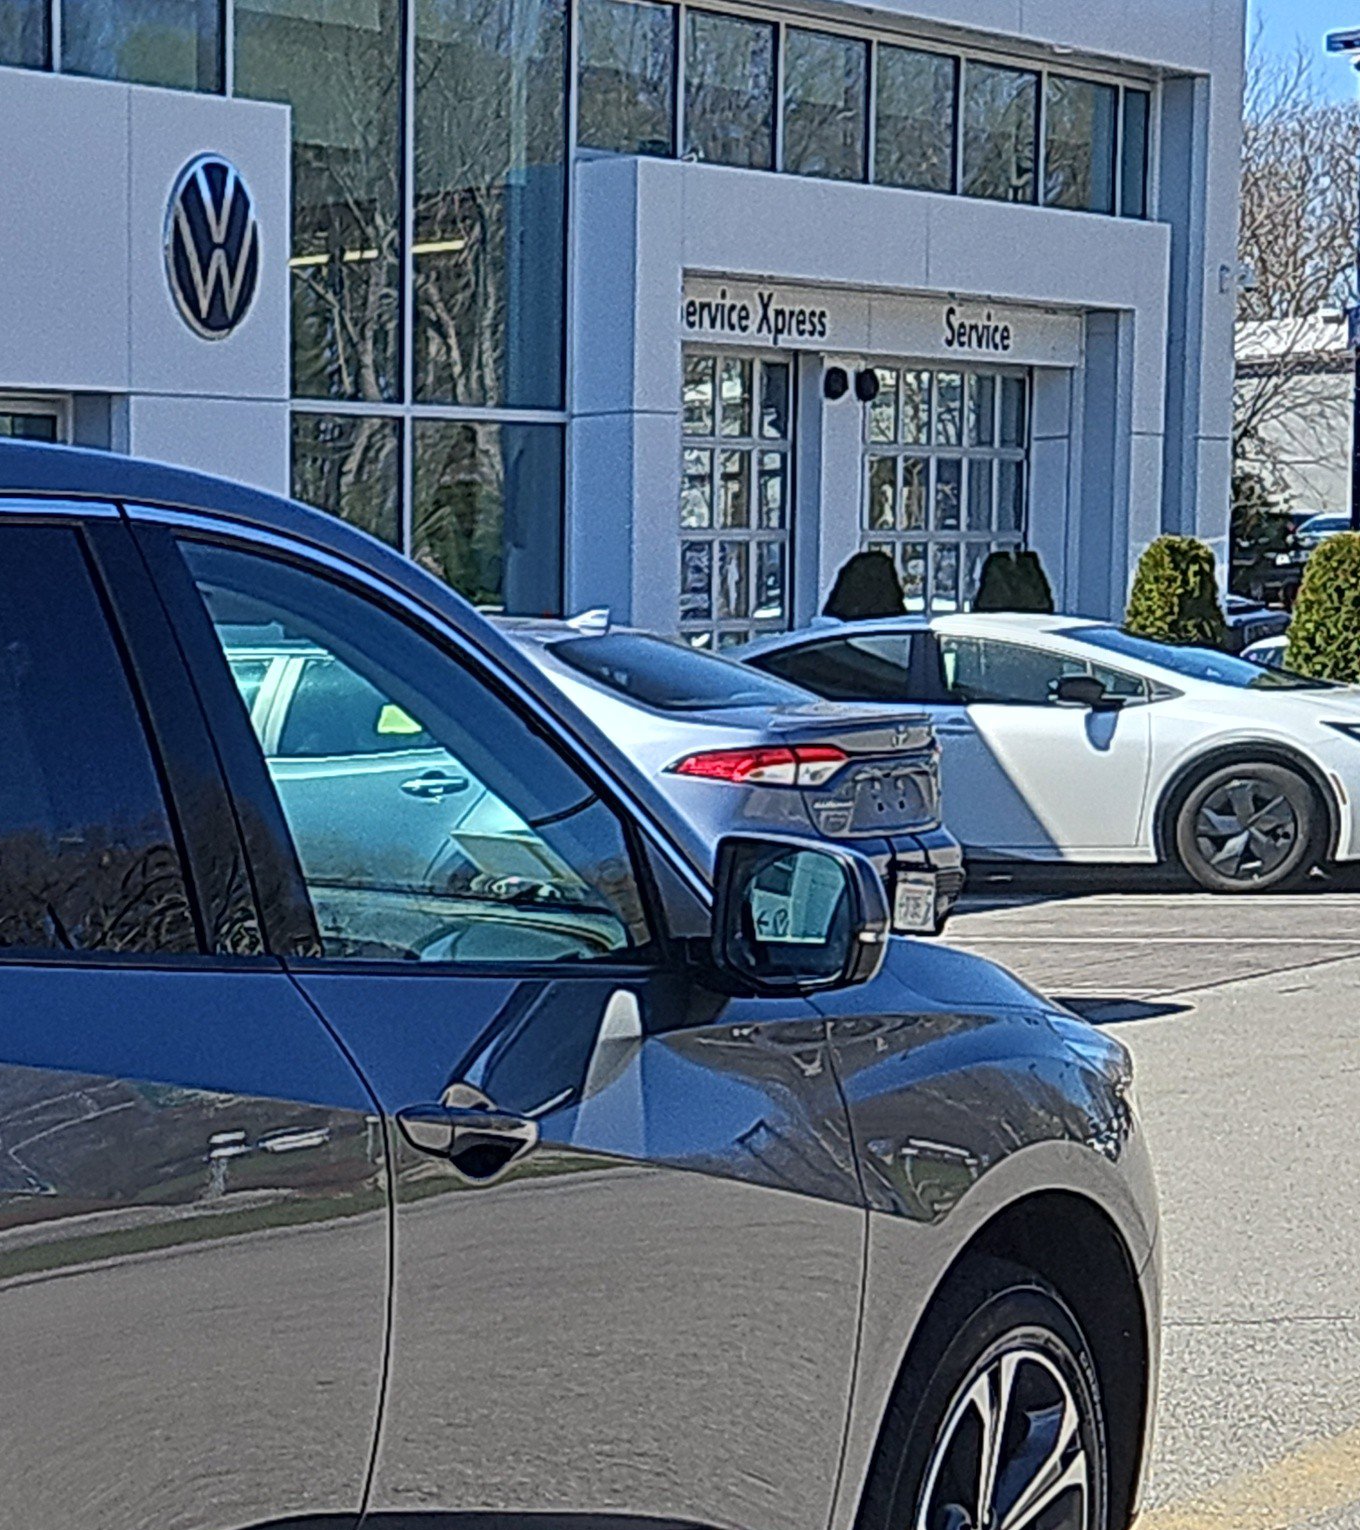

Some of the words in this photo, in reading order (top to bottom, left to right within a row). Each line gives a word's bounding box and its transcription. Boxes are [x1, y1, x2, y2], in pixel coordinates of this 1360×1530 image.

[680, 288, 750, 333] ervice
[756, 291, 828, 346] Xpress
[944, 305, 1012, 351] Service
